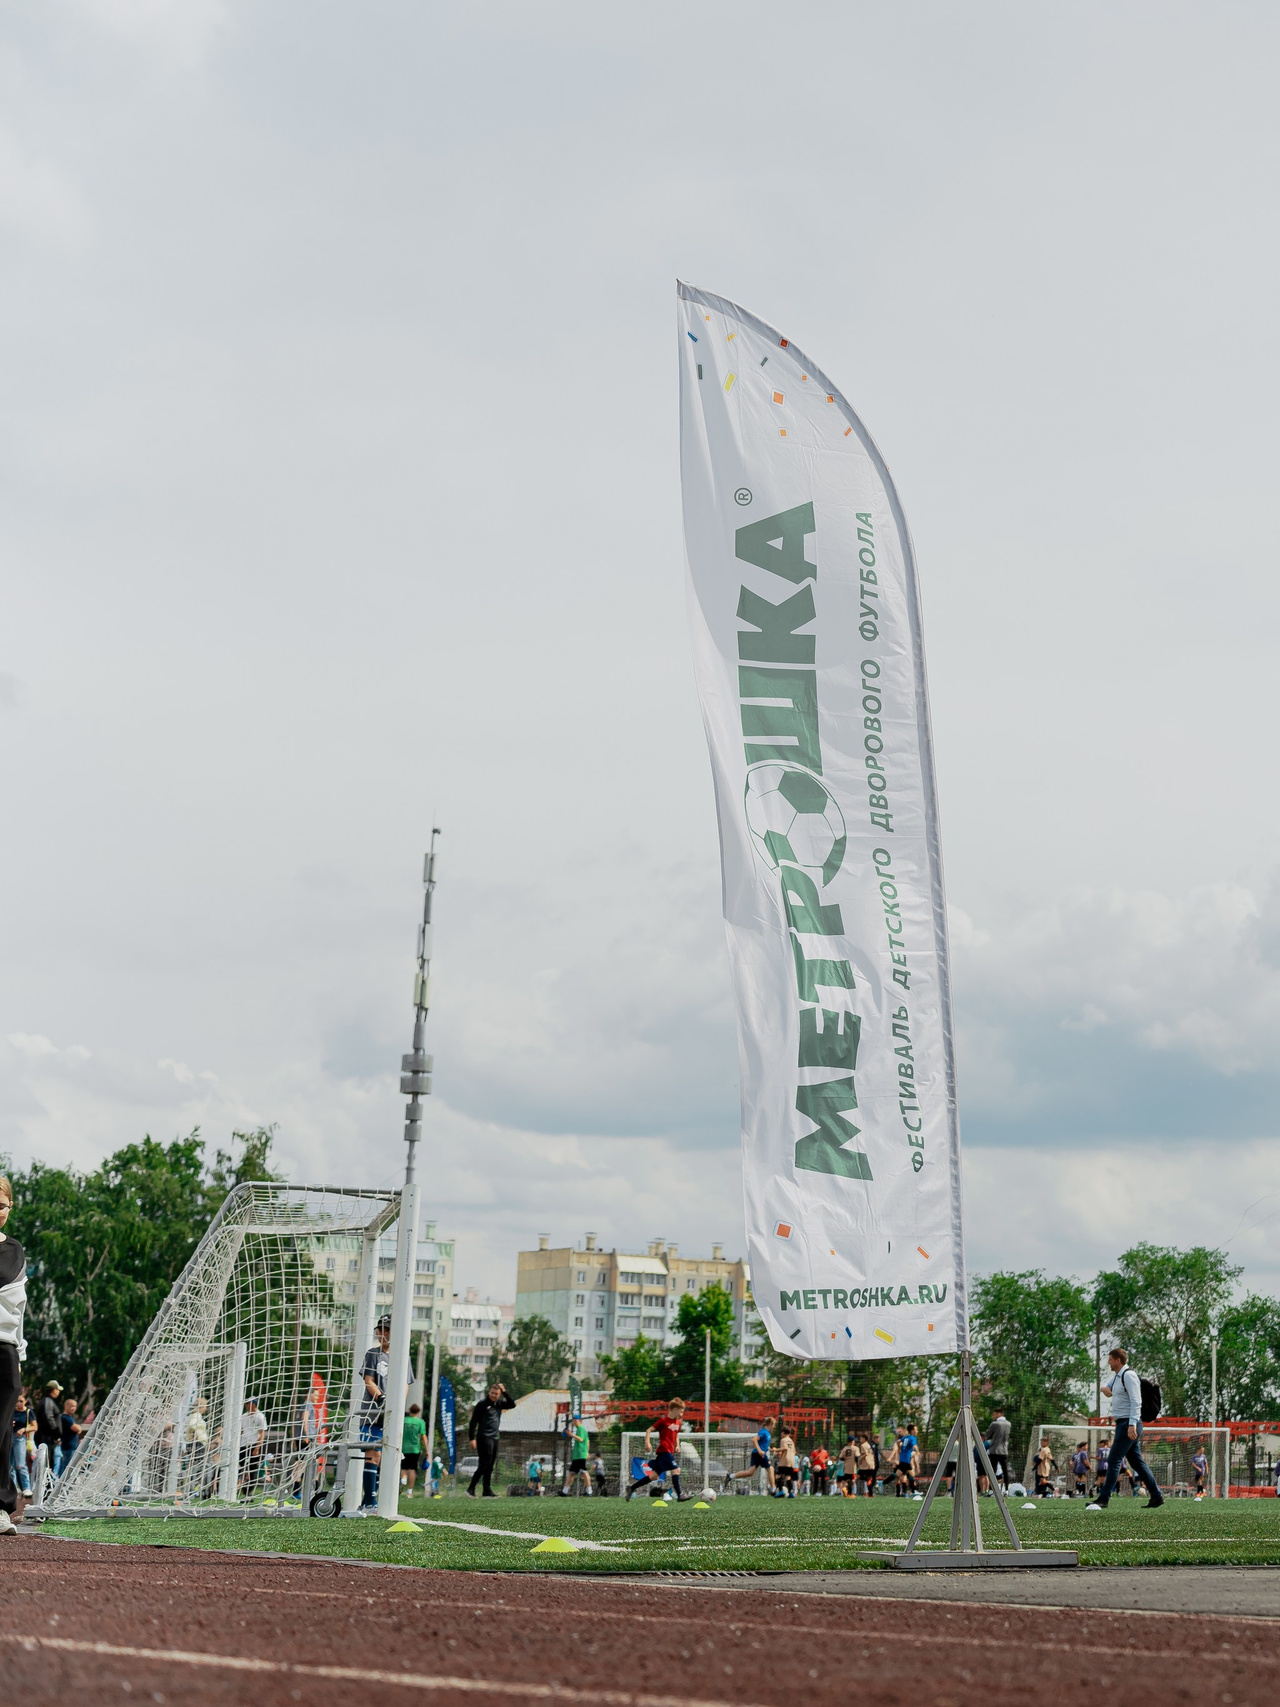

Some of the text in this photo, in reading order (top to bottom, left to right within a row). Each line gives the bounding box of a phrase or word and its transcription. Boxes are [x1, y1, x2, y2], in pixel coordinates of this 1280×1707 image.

[855, 511, 927, 1173] ФЕСТИВАЛЬ ДЕТСКОГО ДВОРОВОГО ФУТБОЛА
[779, 1283, 948, 1312] METROSHKA.RU
